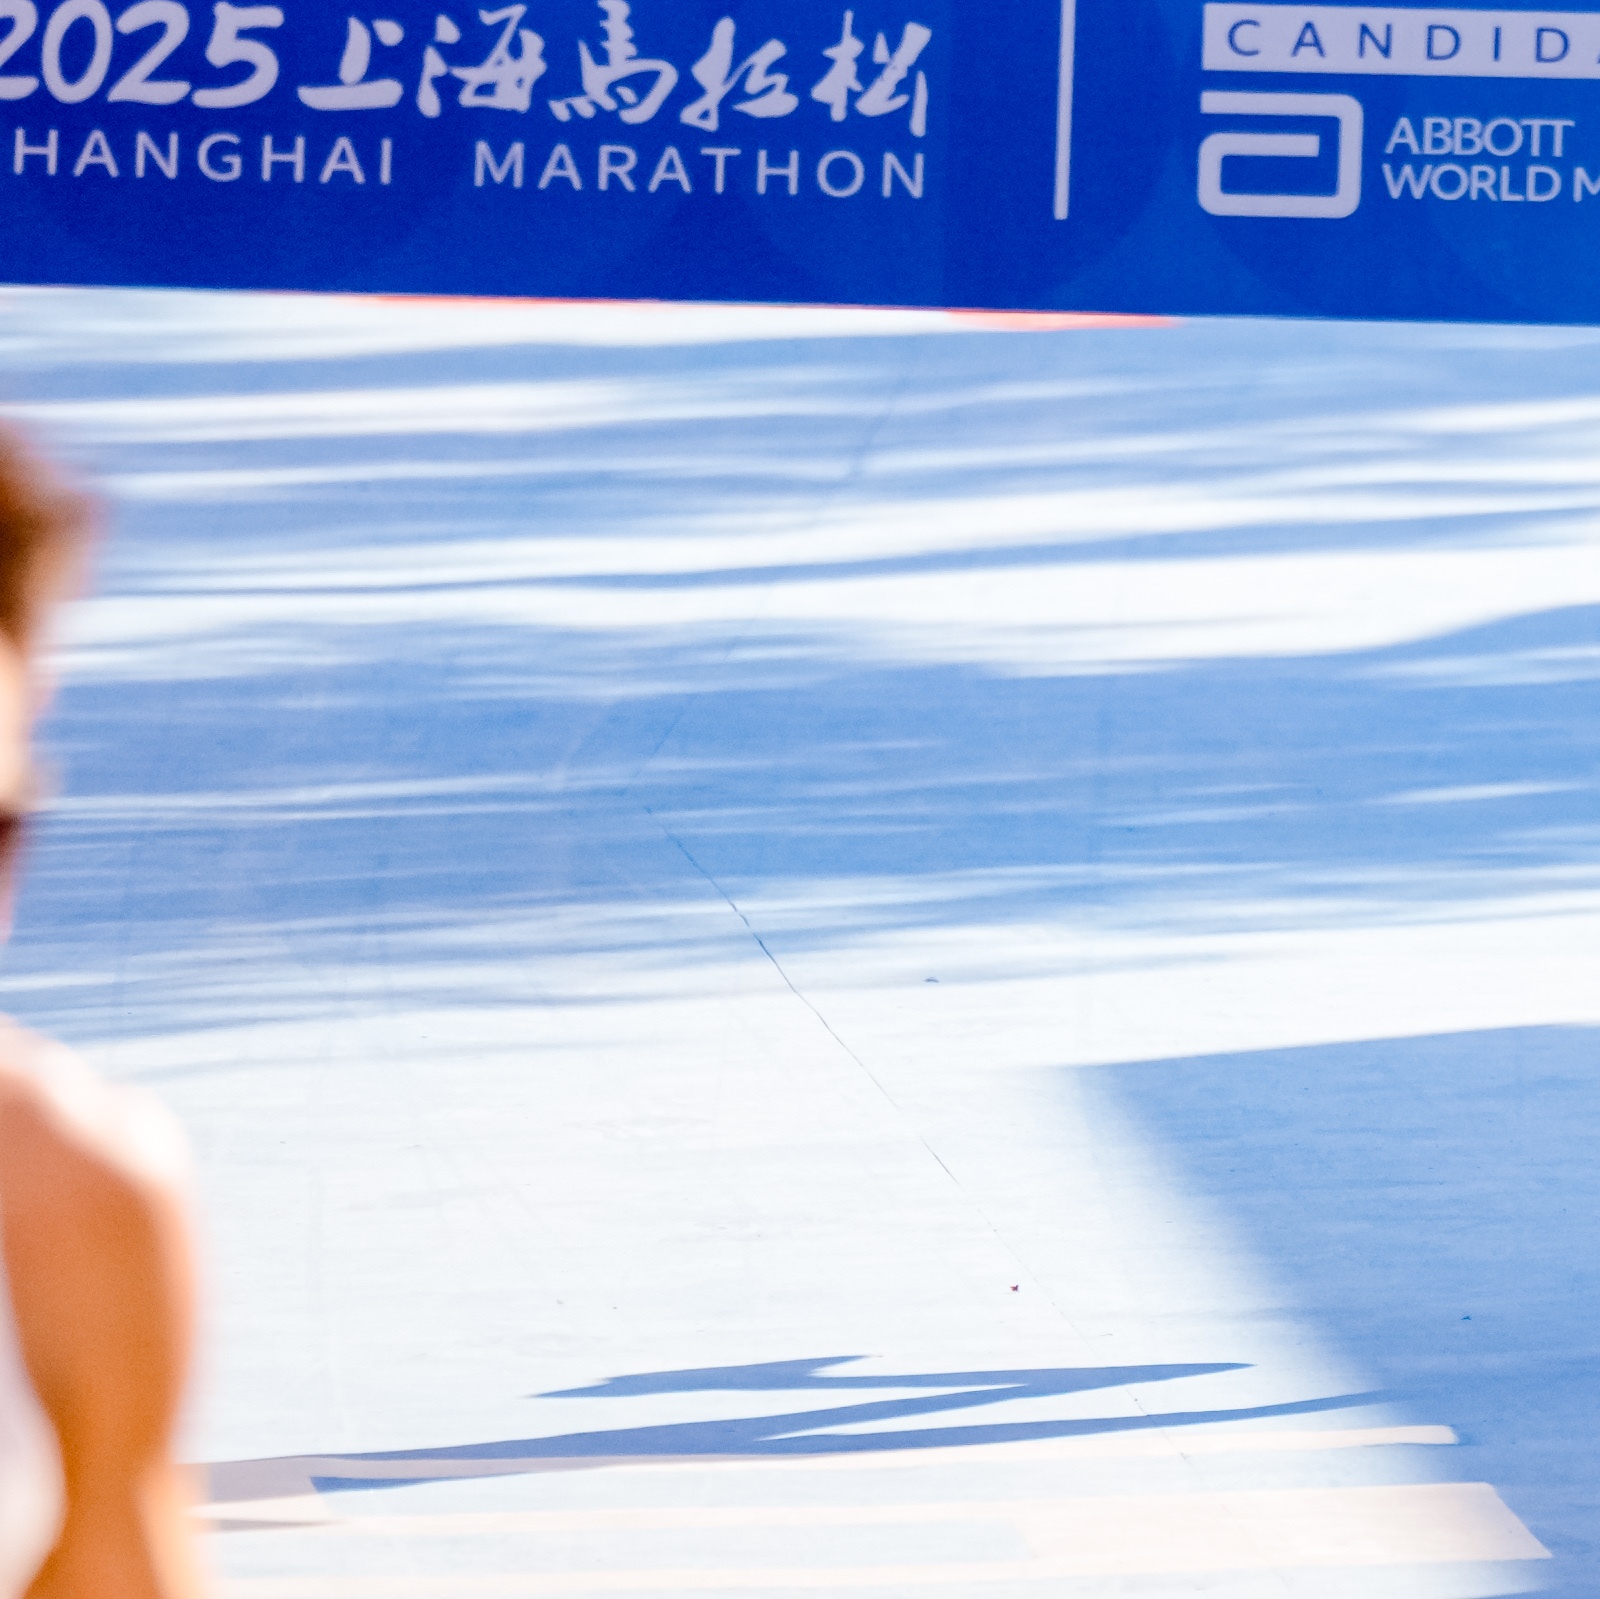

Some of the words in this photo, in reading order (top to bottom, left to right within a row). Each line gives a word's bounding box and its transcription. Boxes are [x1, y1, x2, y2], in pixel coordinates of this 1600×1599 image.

[1385, 116, 1575, 157] ABBOTT
[474, 140, 925, 199] MARATHON
[1383, 164, 1561, 202] WORLD
